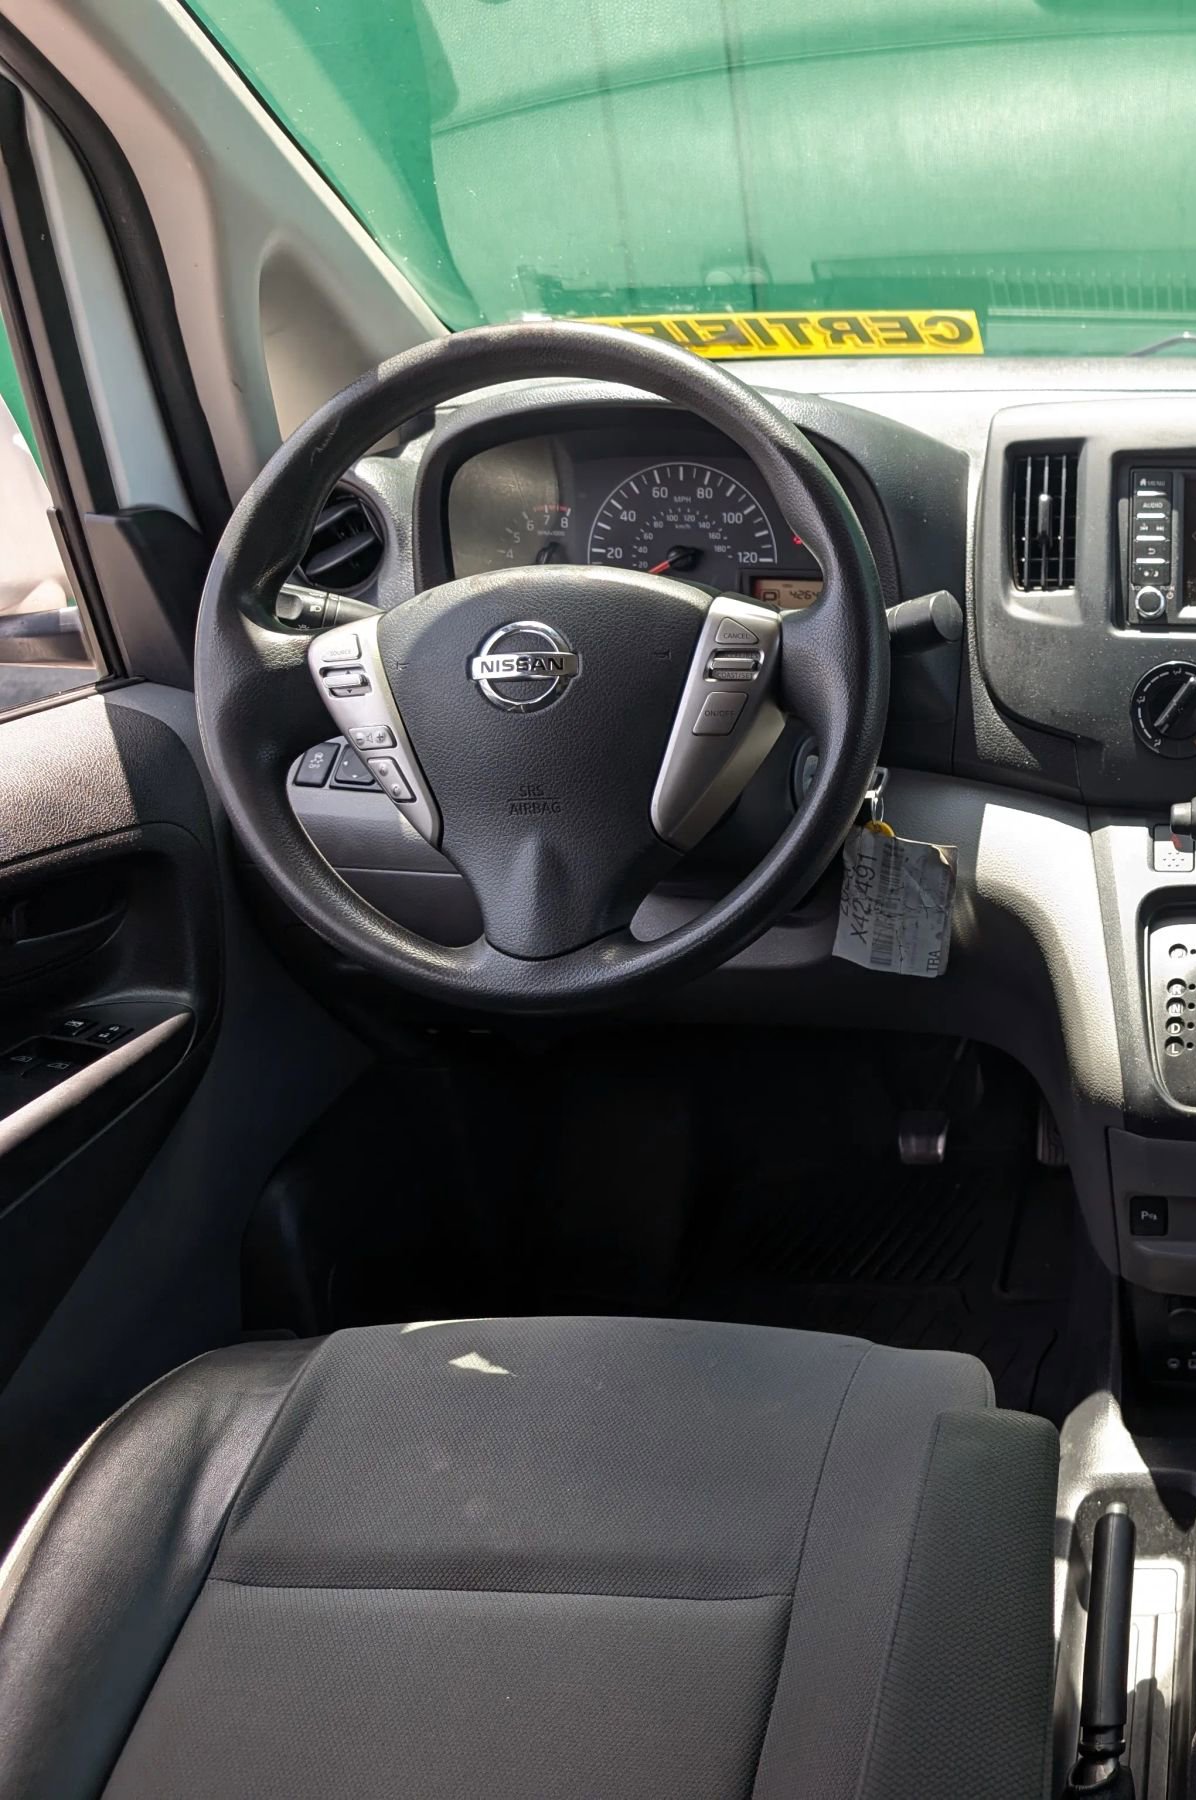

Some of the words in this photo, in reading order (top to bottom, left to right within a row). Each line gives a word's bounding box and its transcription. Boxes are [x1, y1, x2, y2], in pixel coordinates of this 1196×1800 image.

[652, 487, 669, 499] 60
[697, 487, 714, 499] 80
[674, 496, 692, 504] MPH
[544, 515, 551, 526] 7
[620, 511, 636, 522] 40
[666, 514, 679, 522] 100
[684, 514, 696, 522] 120
[722, 512, 743, 524] 100
[527, 521, 535, 532] 6
[561, 517, 569, 529] 8
[653, 521, 664, 529] 80
[698, 521, 711, 529] 140
[513, 532, 521, 544] 5
[643, 532, 655, 540] 60
[708, 532, 721, 540] 160
[506, 549, 514, 559] 4
[607, 547, 623, 559] 20
[638, 546, 648, 554] 40
[714, 545, 727, 553] 180
[738, 551, 758, 563] 120
[762, 592, 777, 602] P
[723, 632, 750, 640] CANCEL
[480, 657, 565, 674] NISSAN
[518, 784, 545, 797] SRS
[508, 801, 562, 816] AIRBAG
[1172, 985, 1182, 996] R
[1172, 1003, 1182, 1014] N
[1171, 1023, 1181, 1034] D
[1171, 1043, 1179, 1054] L
